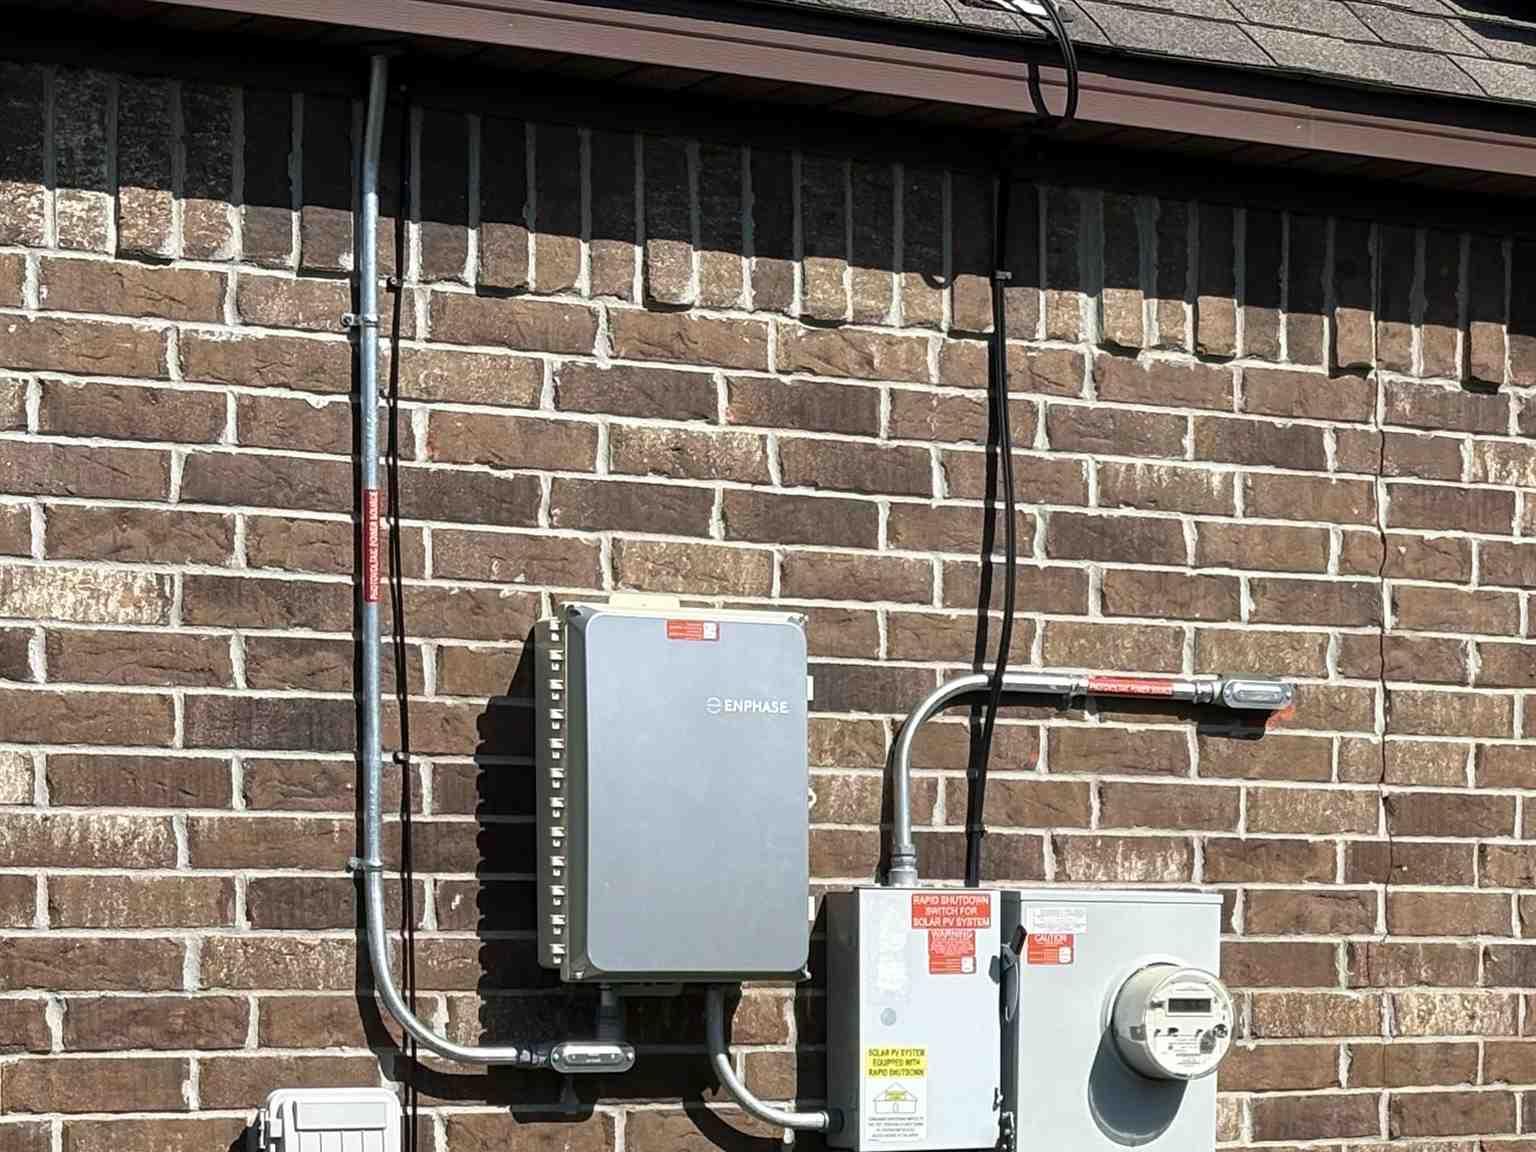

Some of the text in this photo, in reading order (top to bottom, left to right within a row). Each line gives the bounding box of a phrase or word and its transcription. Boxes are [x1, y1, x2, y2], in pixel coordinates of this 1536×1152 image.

[369, 521, 378, 547] POWER
[724, 699, 789, 714] ENPHASE
[912, 895, 989, 905] RAPID SHUTDOWN
[926, 906, 977, 916] SWITCH FOR
[913, 917, 942, 927] SOLAR
[957, 917, 990, 927] SYSTEM
[868, 1048, 889, 1057] SOLAR
[901, 1048, 925, 1057] SYSTEM
[868, 1068, 888, 1077] RAPID
